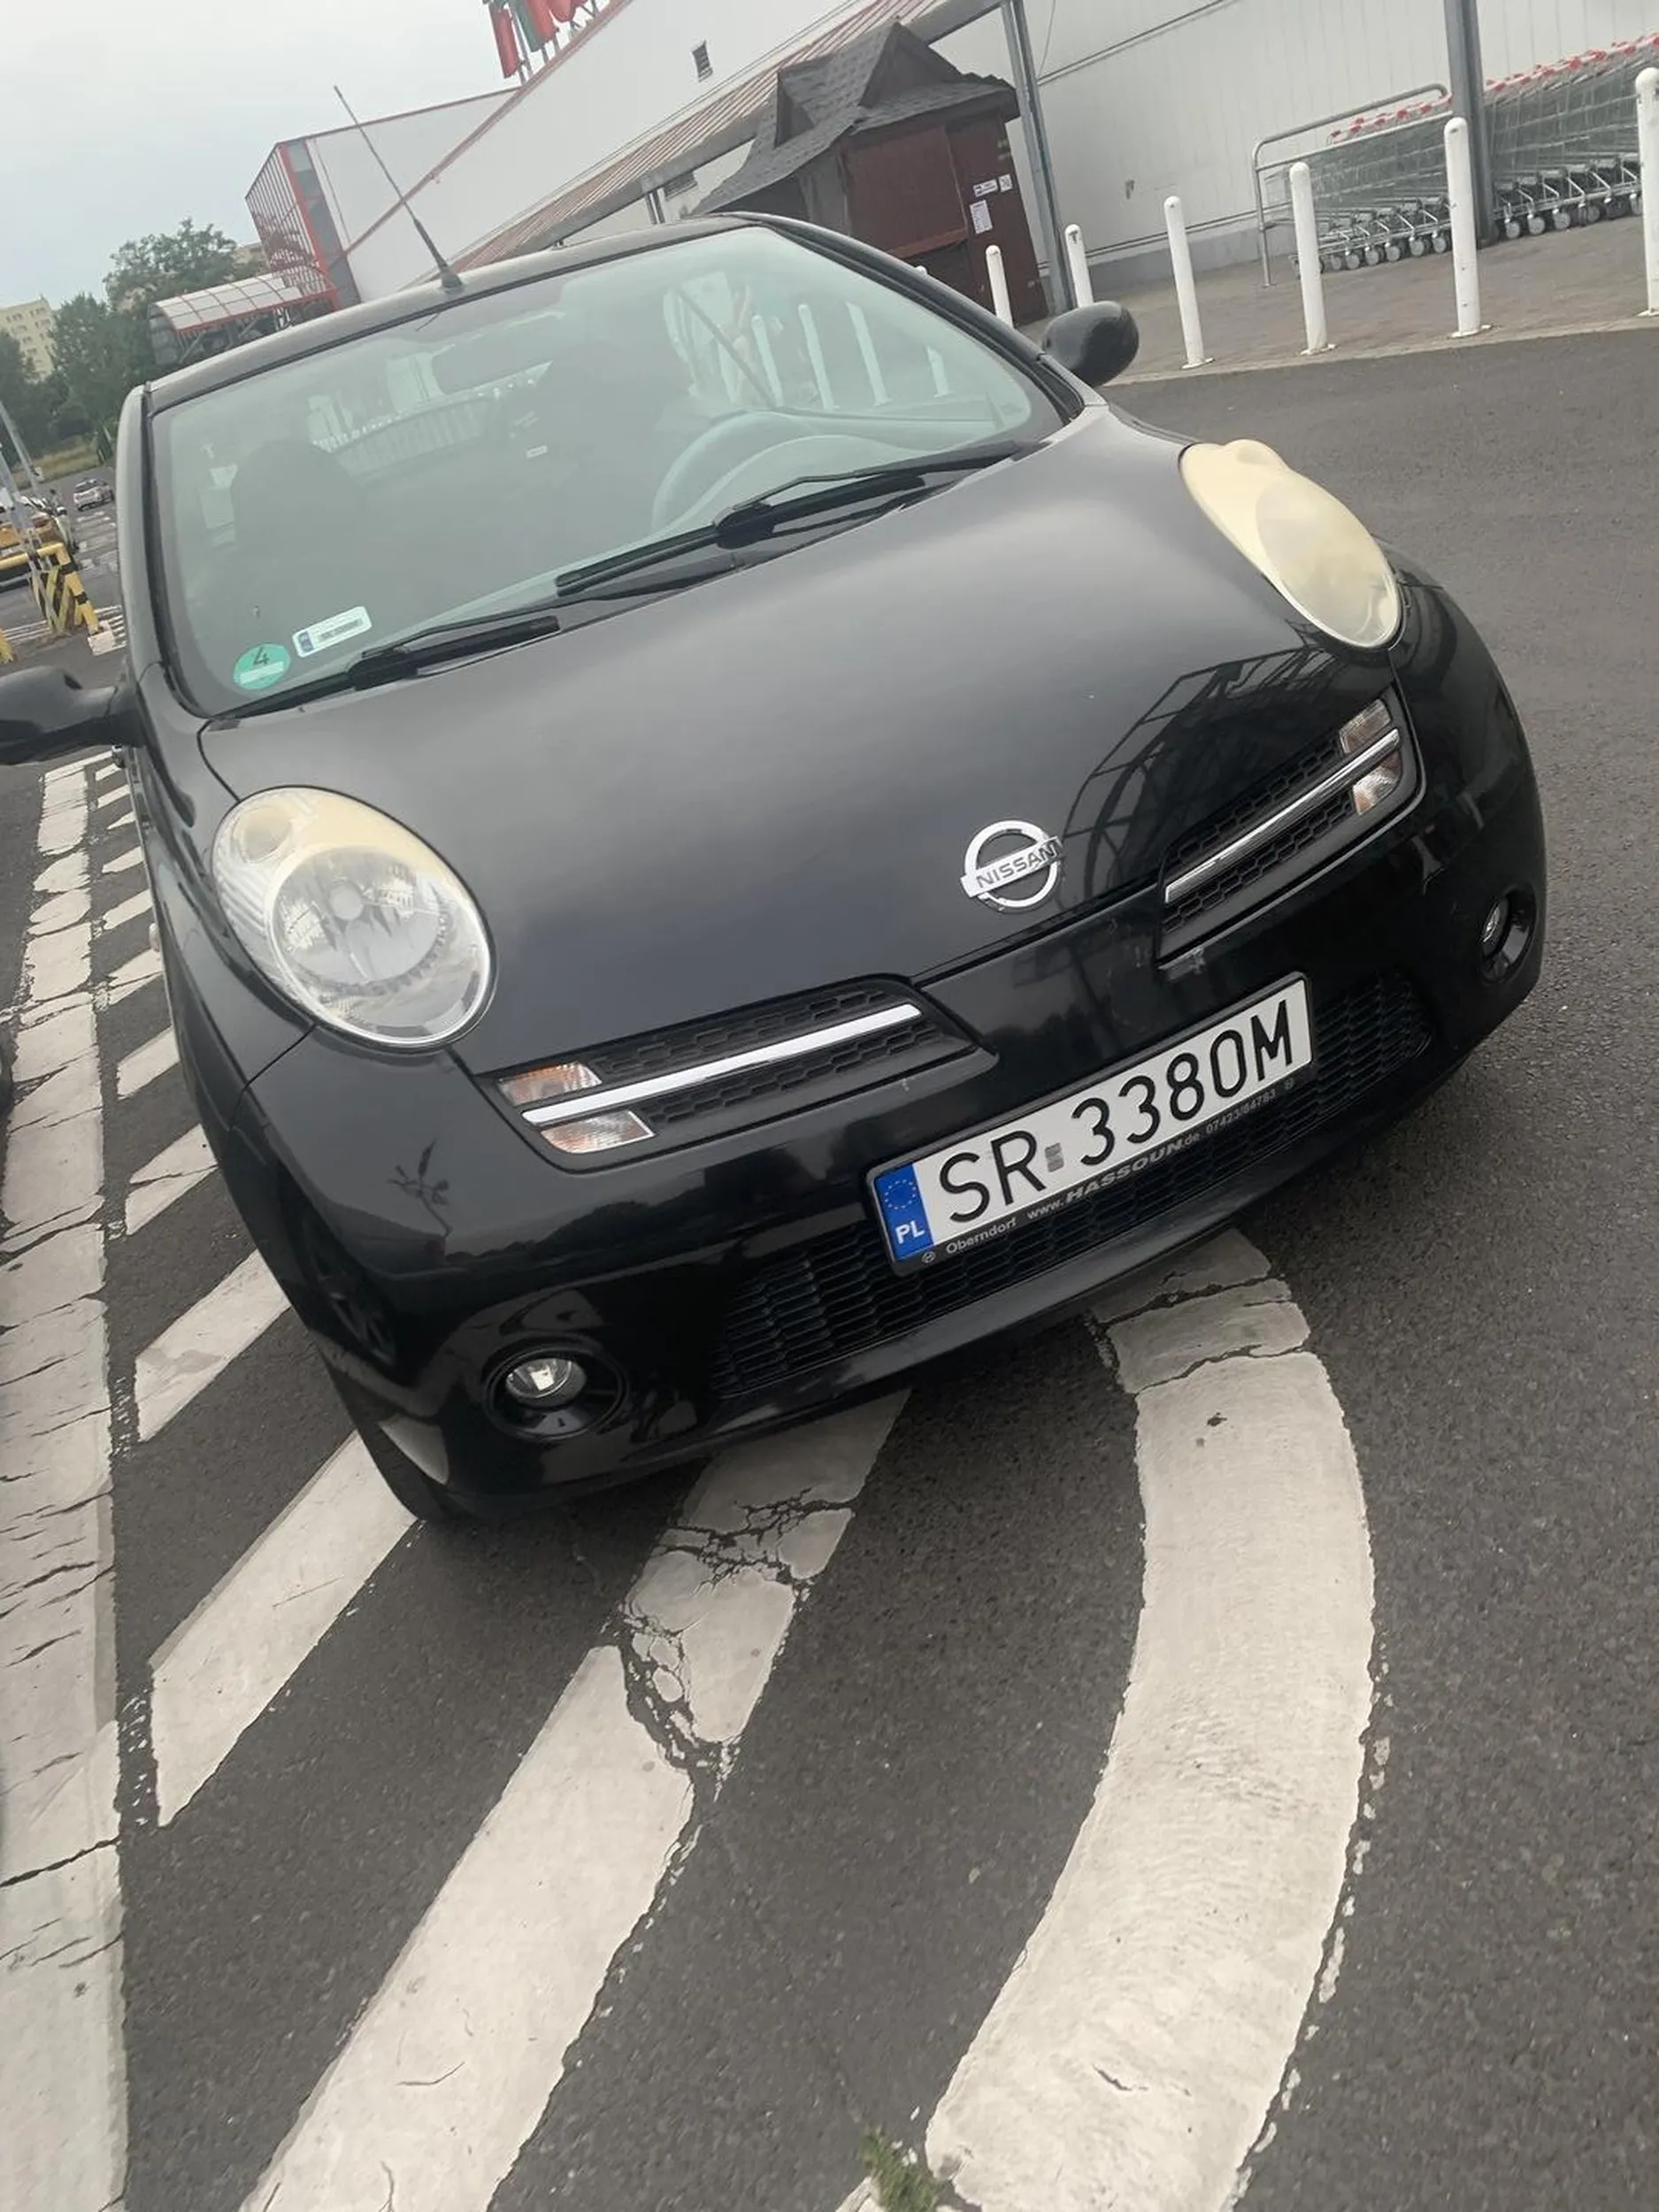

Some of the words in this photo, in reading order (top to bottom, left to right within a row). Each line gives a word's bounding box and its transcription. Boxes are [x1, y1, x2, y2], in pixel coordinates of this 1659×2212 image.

[252, 647, 271, 665] 4
[975, 840, 1060, 888] NISSAN
[939, 1130, 1047, 1224] SR
[1071, 999, 1294, 1166] 3380M
[895, 1220, 926, 1244] PL
[946, 1217, 1018, 1254] Oberndorf
